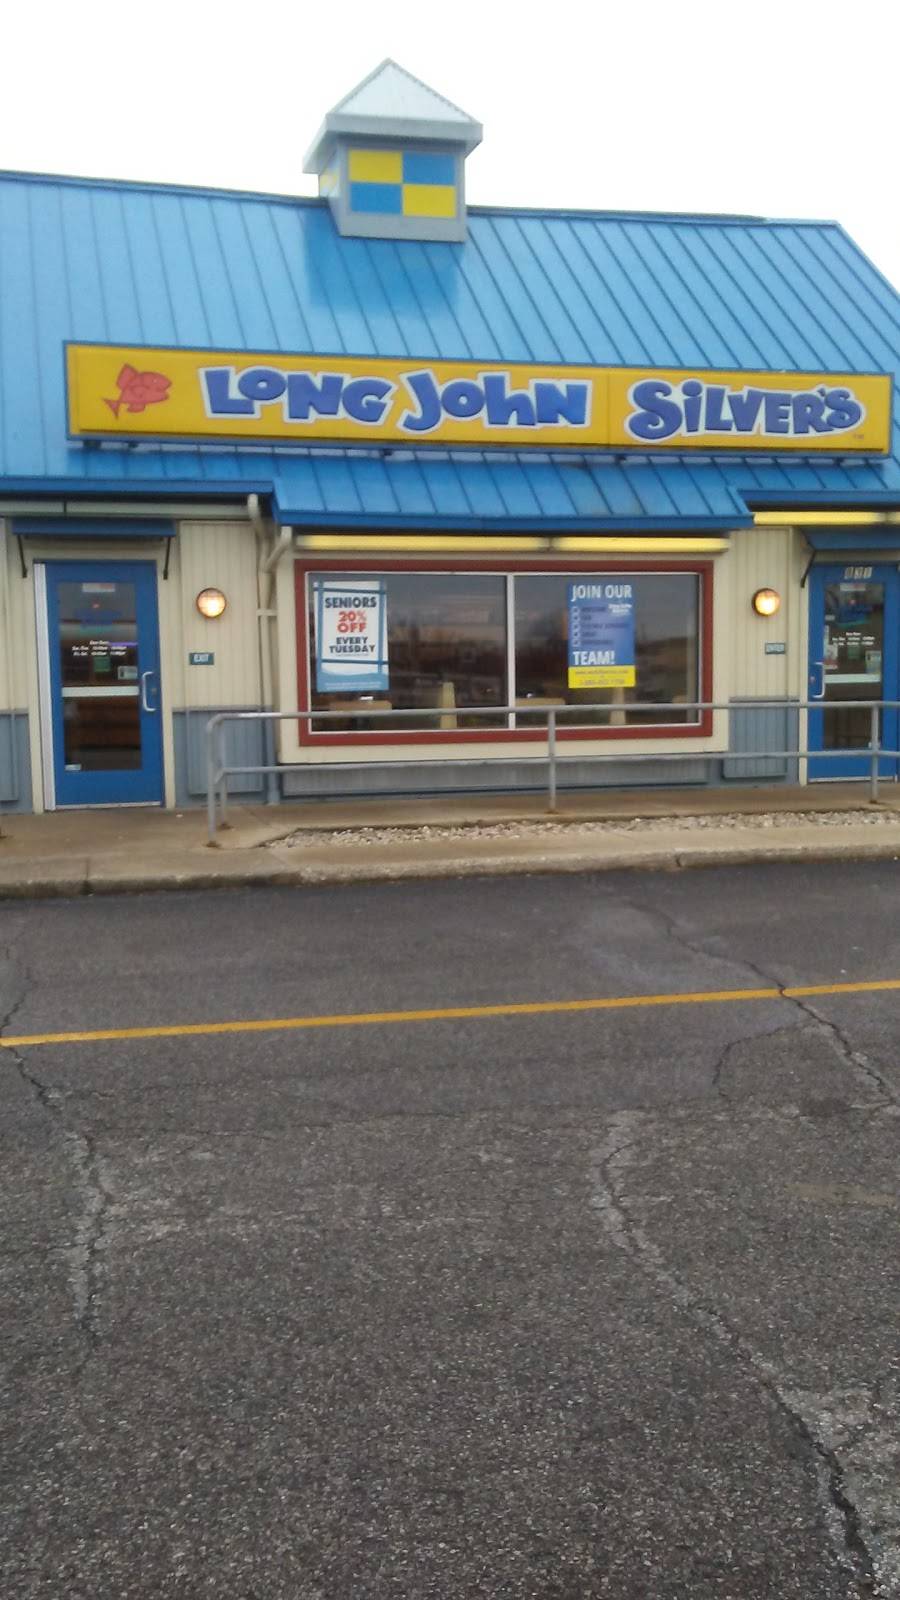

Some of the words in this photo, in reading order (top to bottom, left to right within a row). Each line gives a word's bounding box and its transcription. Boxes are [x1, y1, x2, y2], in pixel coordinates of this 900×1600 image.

[199, 365, 391, 424] LONG
[571, 584, 601, 602] JOIN
[605, 584, 633, 599] OUR
[325, 596, 377, 609] SENIORS
[338, 610, 367, 623] 20%
[336, 622, 367, 634] OFF
[336, 636, 369, 645] EVERY
[329, 644, 376, 654] TUESDAY
[573, 650, 616, 666] TEAM!
